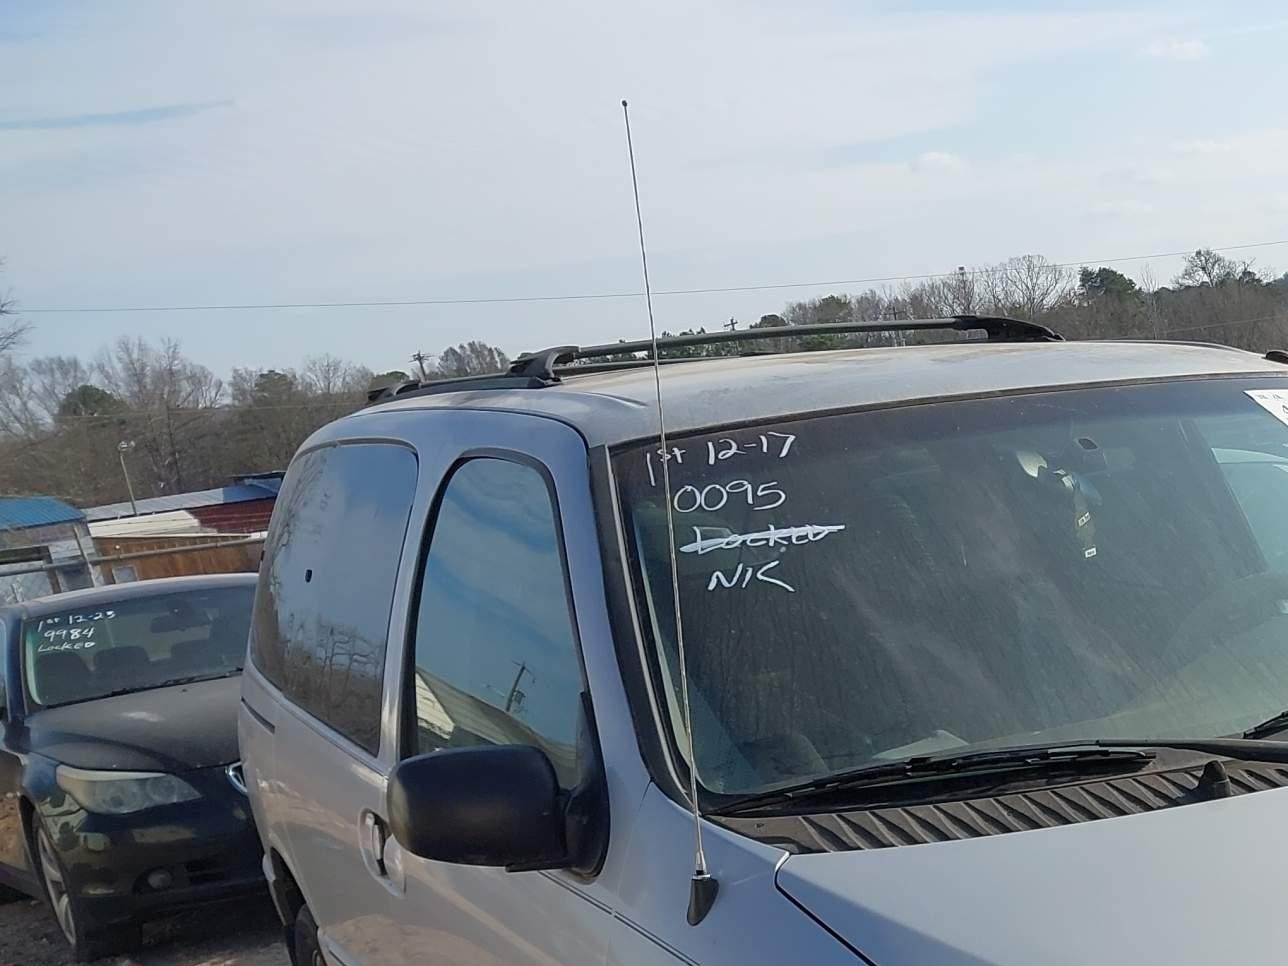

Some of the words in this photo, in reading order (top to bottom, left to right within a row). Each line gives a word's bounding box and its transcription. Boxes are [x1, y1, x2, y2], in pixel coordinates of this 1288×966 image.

[645, 447, 688, 487] 1st
[706, 431, 797, 466] 12-17
[673, 479, 787, 514] 0095
[43, 627, 95, 642] 9984
